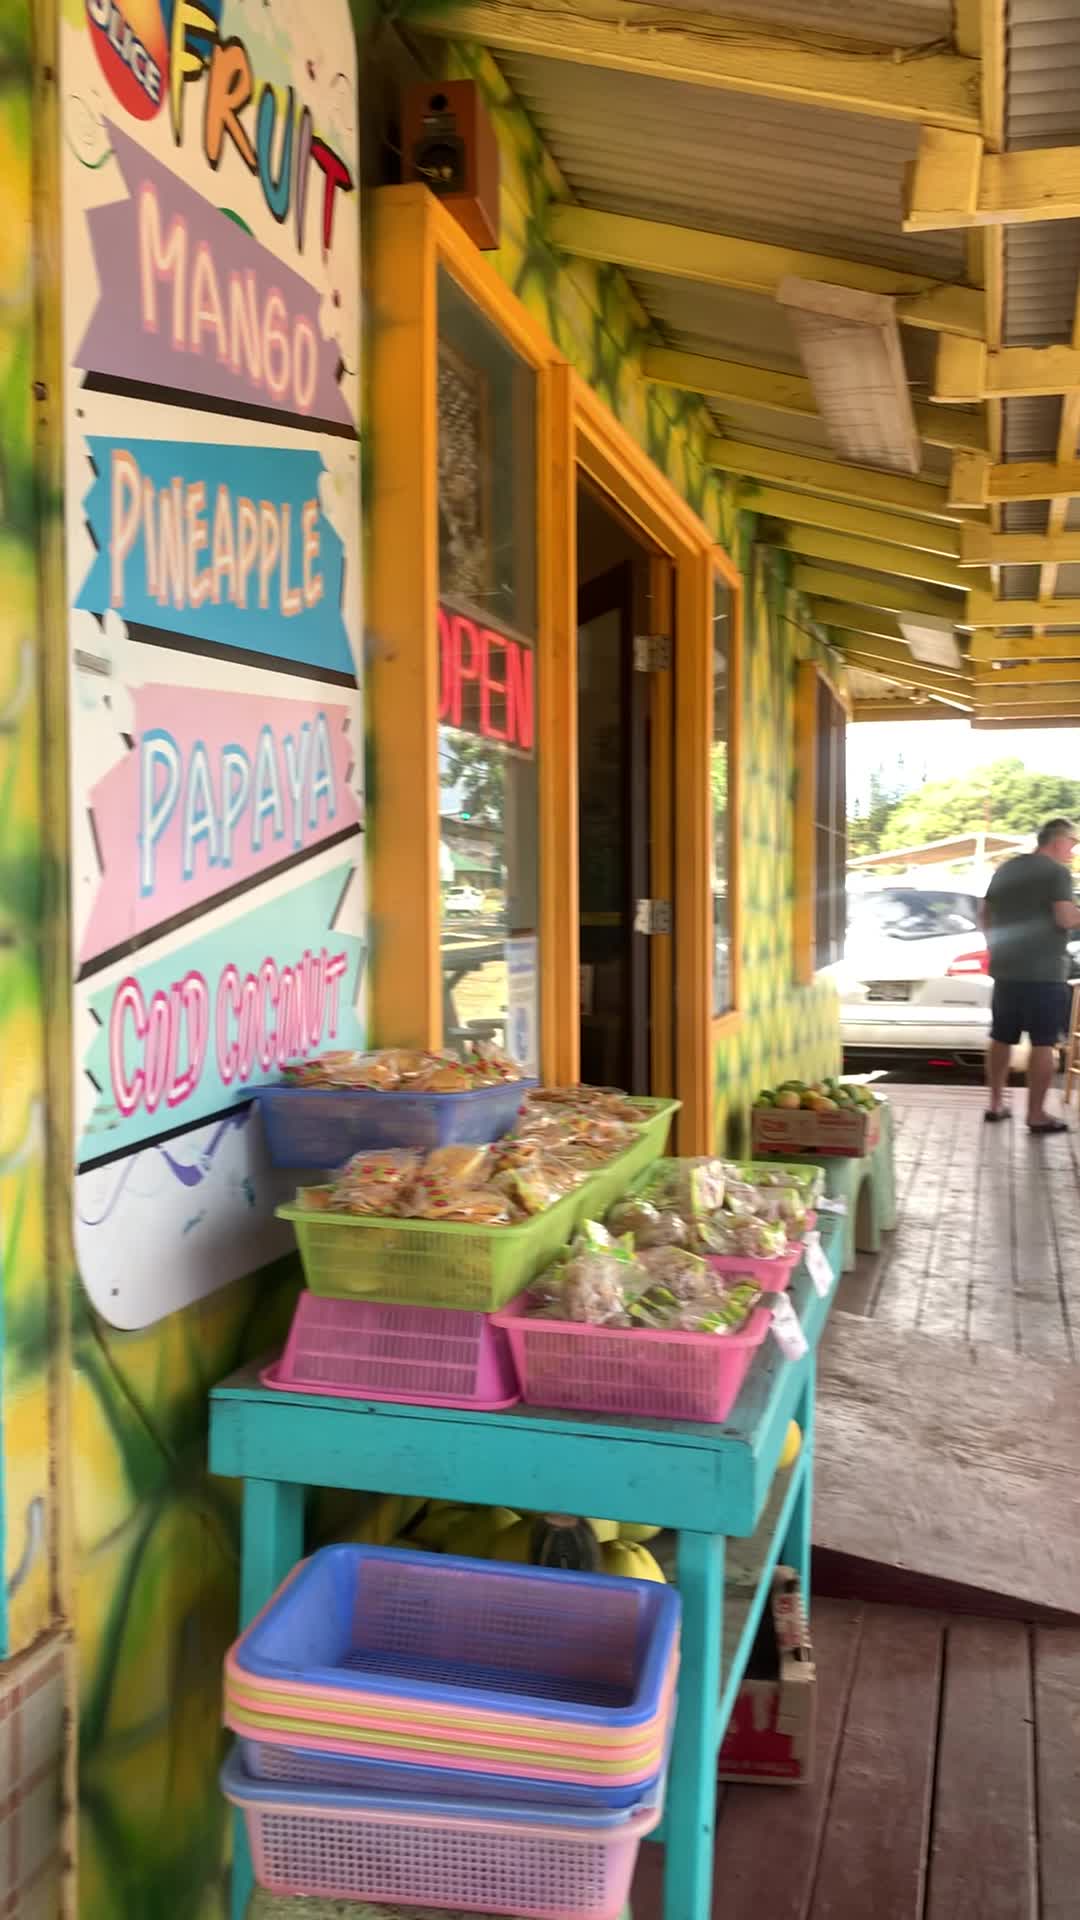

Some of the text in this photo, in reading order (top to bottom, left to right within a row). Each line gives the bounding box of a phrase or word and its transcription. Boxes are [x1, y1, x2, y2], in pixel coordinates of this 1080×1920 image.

[169, 0, 355, 262] FRUIT
[138, 179, 319, 416] MANGO
[110, 449, 324, 616] PINEAPPLE
[139, 711, 336, 898] PAPAYA
[109, 969, 209, 1117] COLD
[215, 947, 348, 1086] COCONUT
